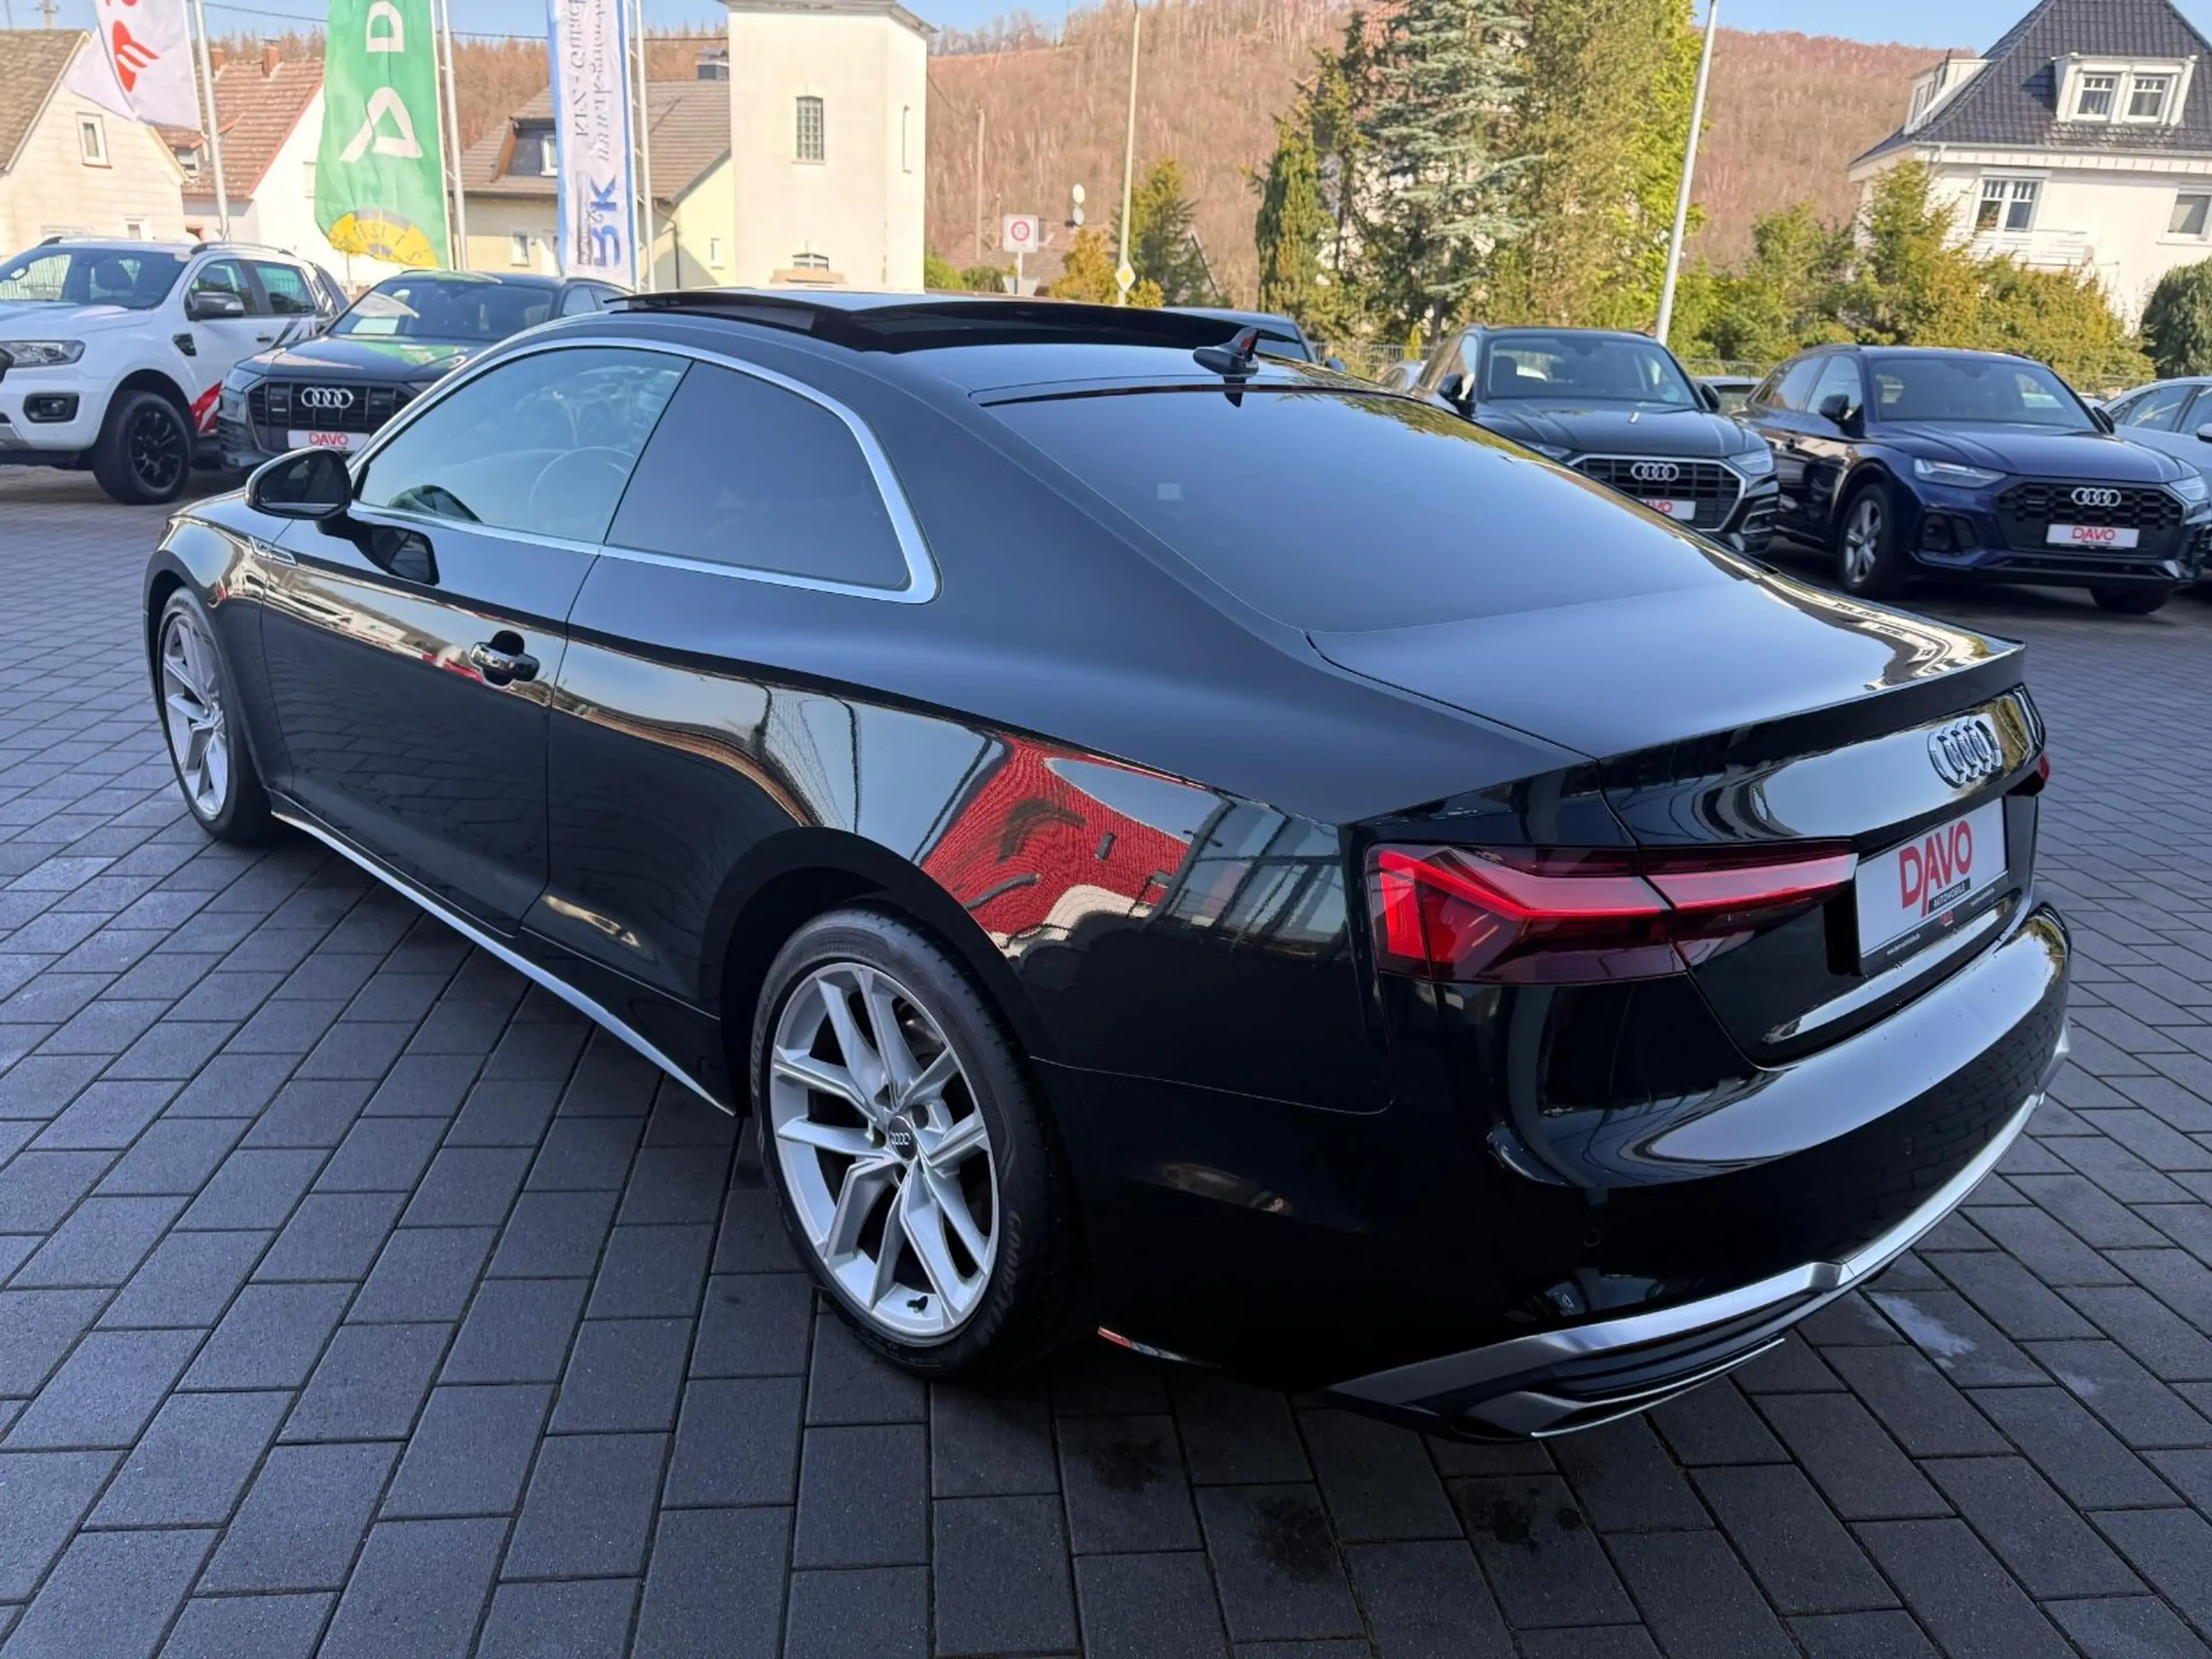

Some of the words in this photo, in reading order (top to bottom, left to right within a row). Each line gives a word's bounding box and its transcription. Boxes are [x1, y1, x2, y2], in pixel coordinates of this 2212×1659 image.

[309, 432, 348, 445] DAVO
[2073, 527, 2115, 541] DAVO
[1898, 820, 1973, 917] DAVO
[1934, 883, 1965, 907] AUTOMOBILE
